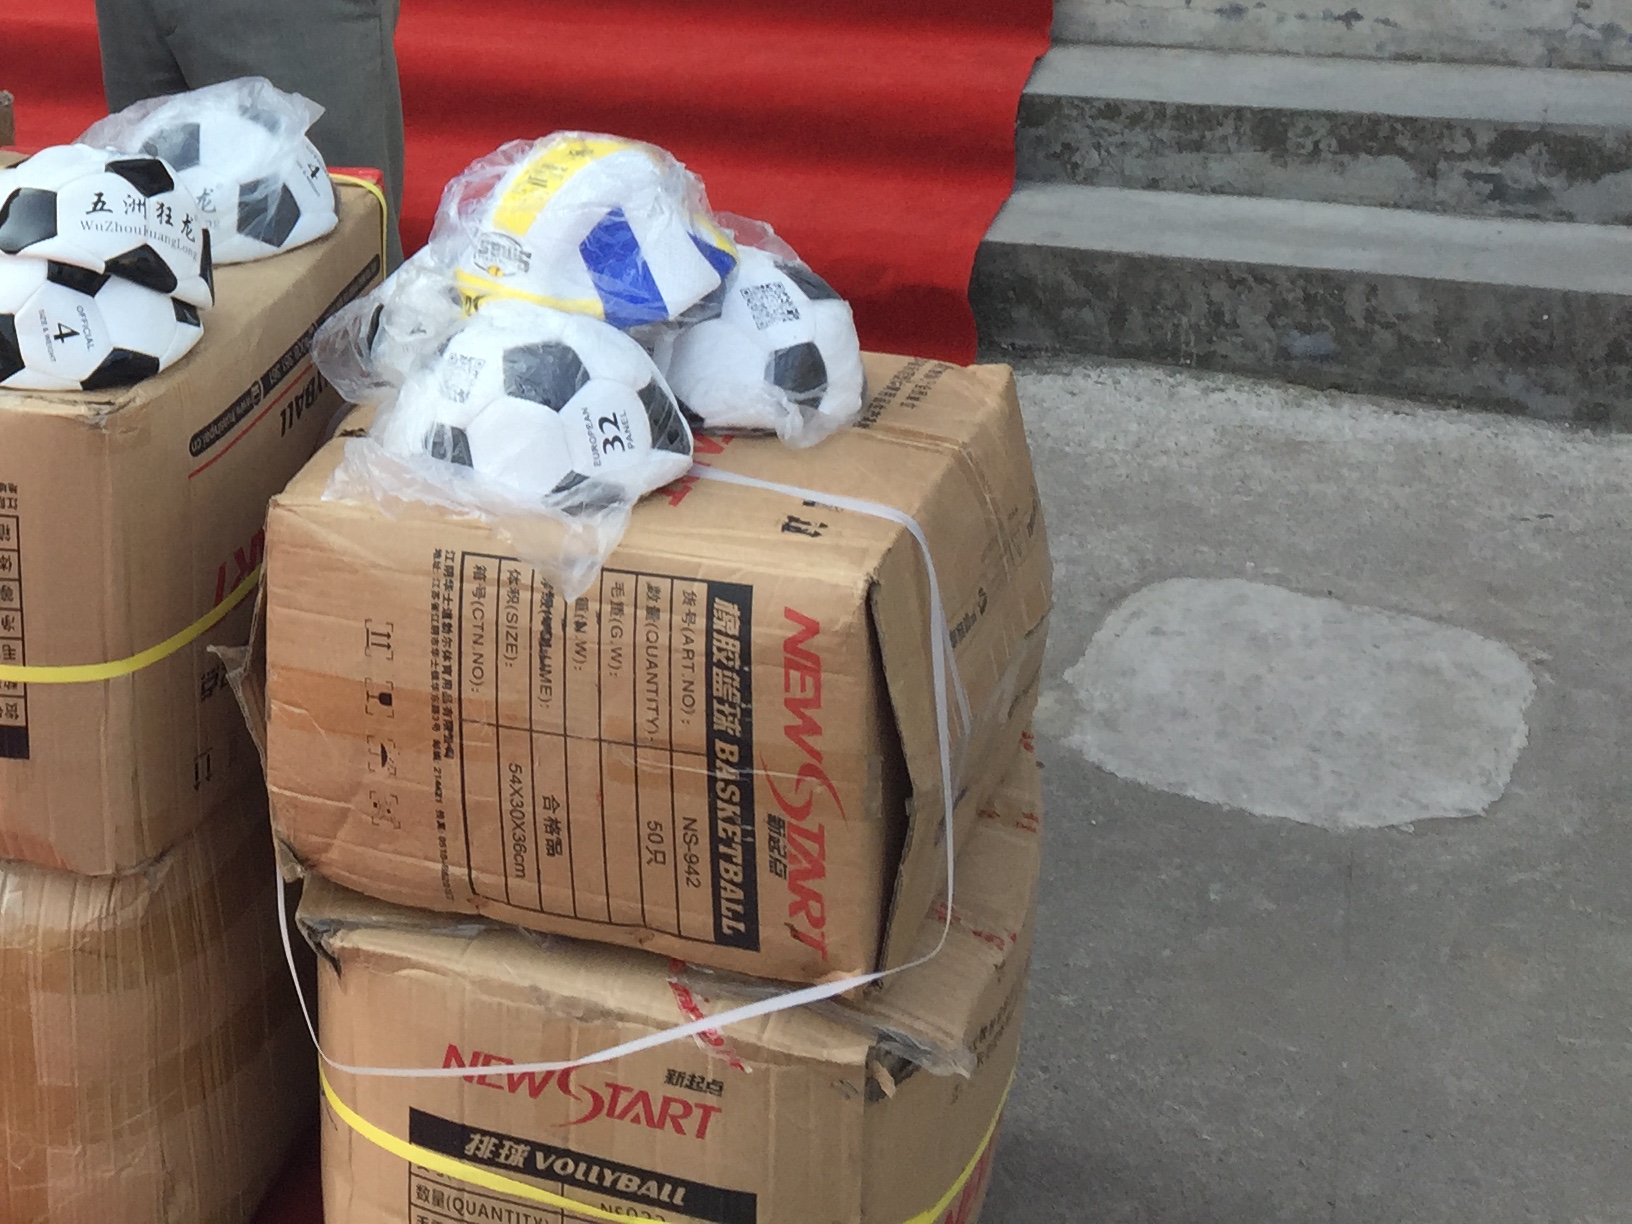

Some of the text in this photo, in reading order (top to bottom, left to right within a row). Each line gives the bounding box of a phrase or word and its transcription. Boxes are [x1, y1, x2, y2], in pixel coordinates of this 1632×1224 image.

[85, 192, 196, 243] 五洲狂龙
[54, 323, 80, 343] 4
[77, 305, 95, 353] OFFICIAL
[581, 407, 602, 467] EUROPEAN
[598, 412, 626, 455] 32
[619, 409, 635, 450] PANEL
[507, 762, 528, 880] 54X30X36cm
[541, 794, 564, 858] 合格品
[646, 819, 667, 867] 50只
[714, 739, 746, 938] BASKETBALL
[681, 815, 702, 889] NS-942
[665, 1068, 725, 1098] 新起点
[464, 1133, 687, 1206] 排球 VOLLYBALL
